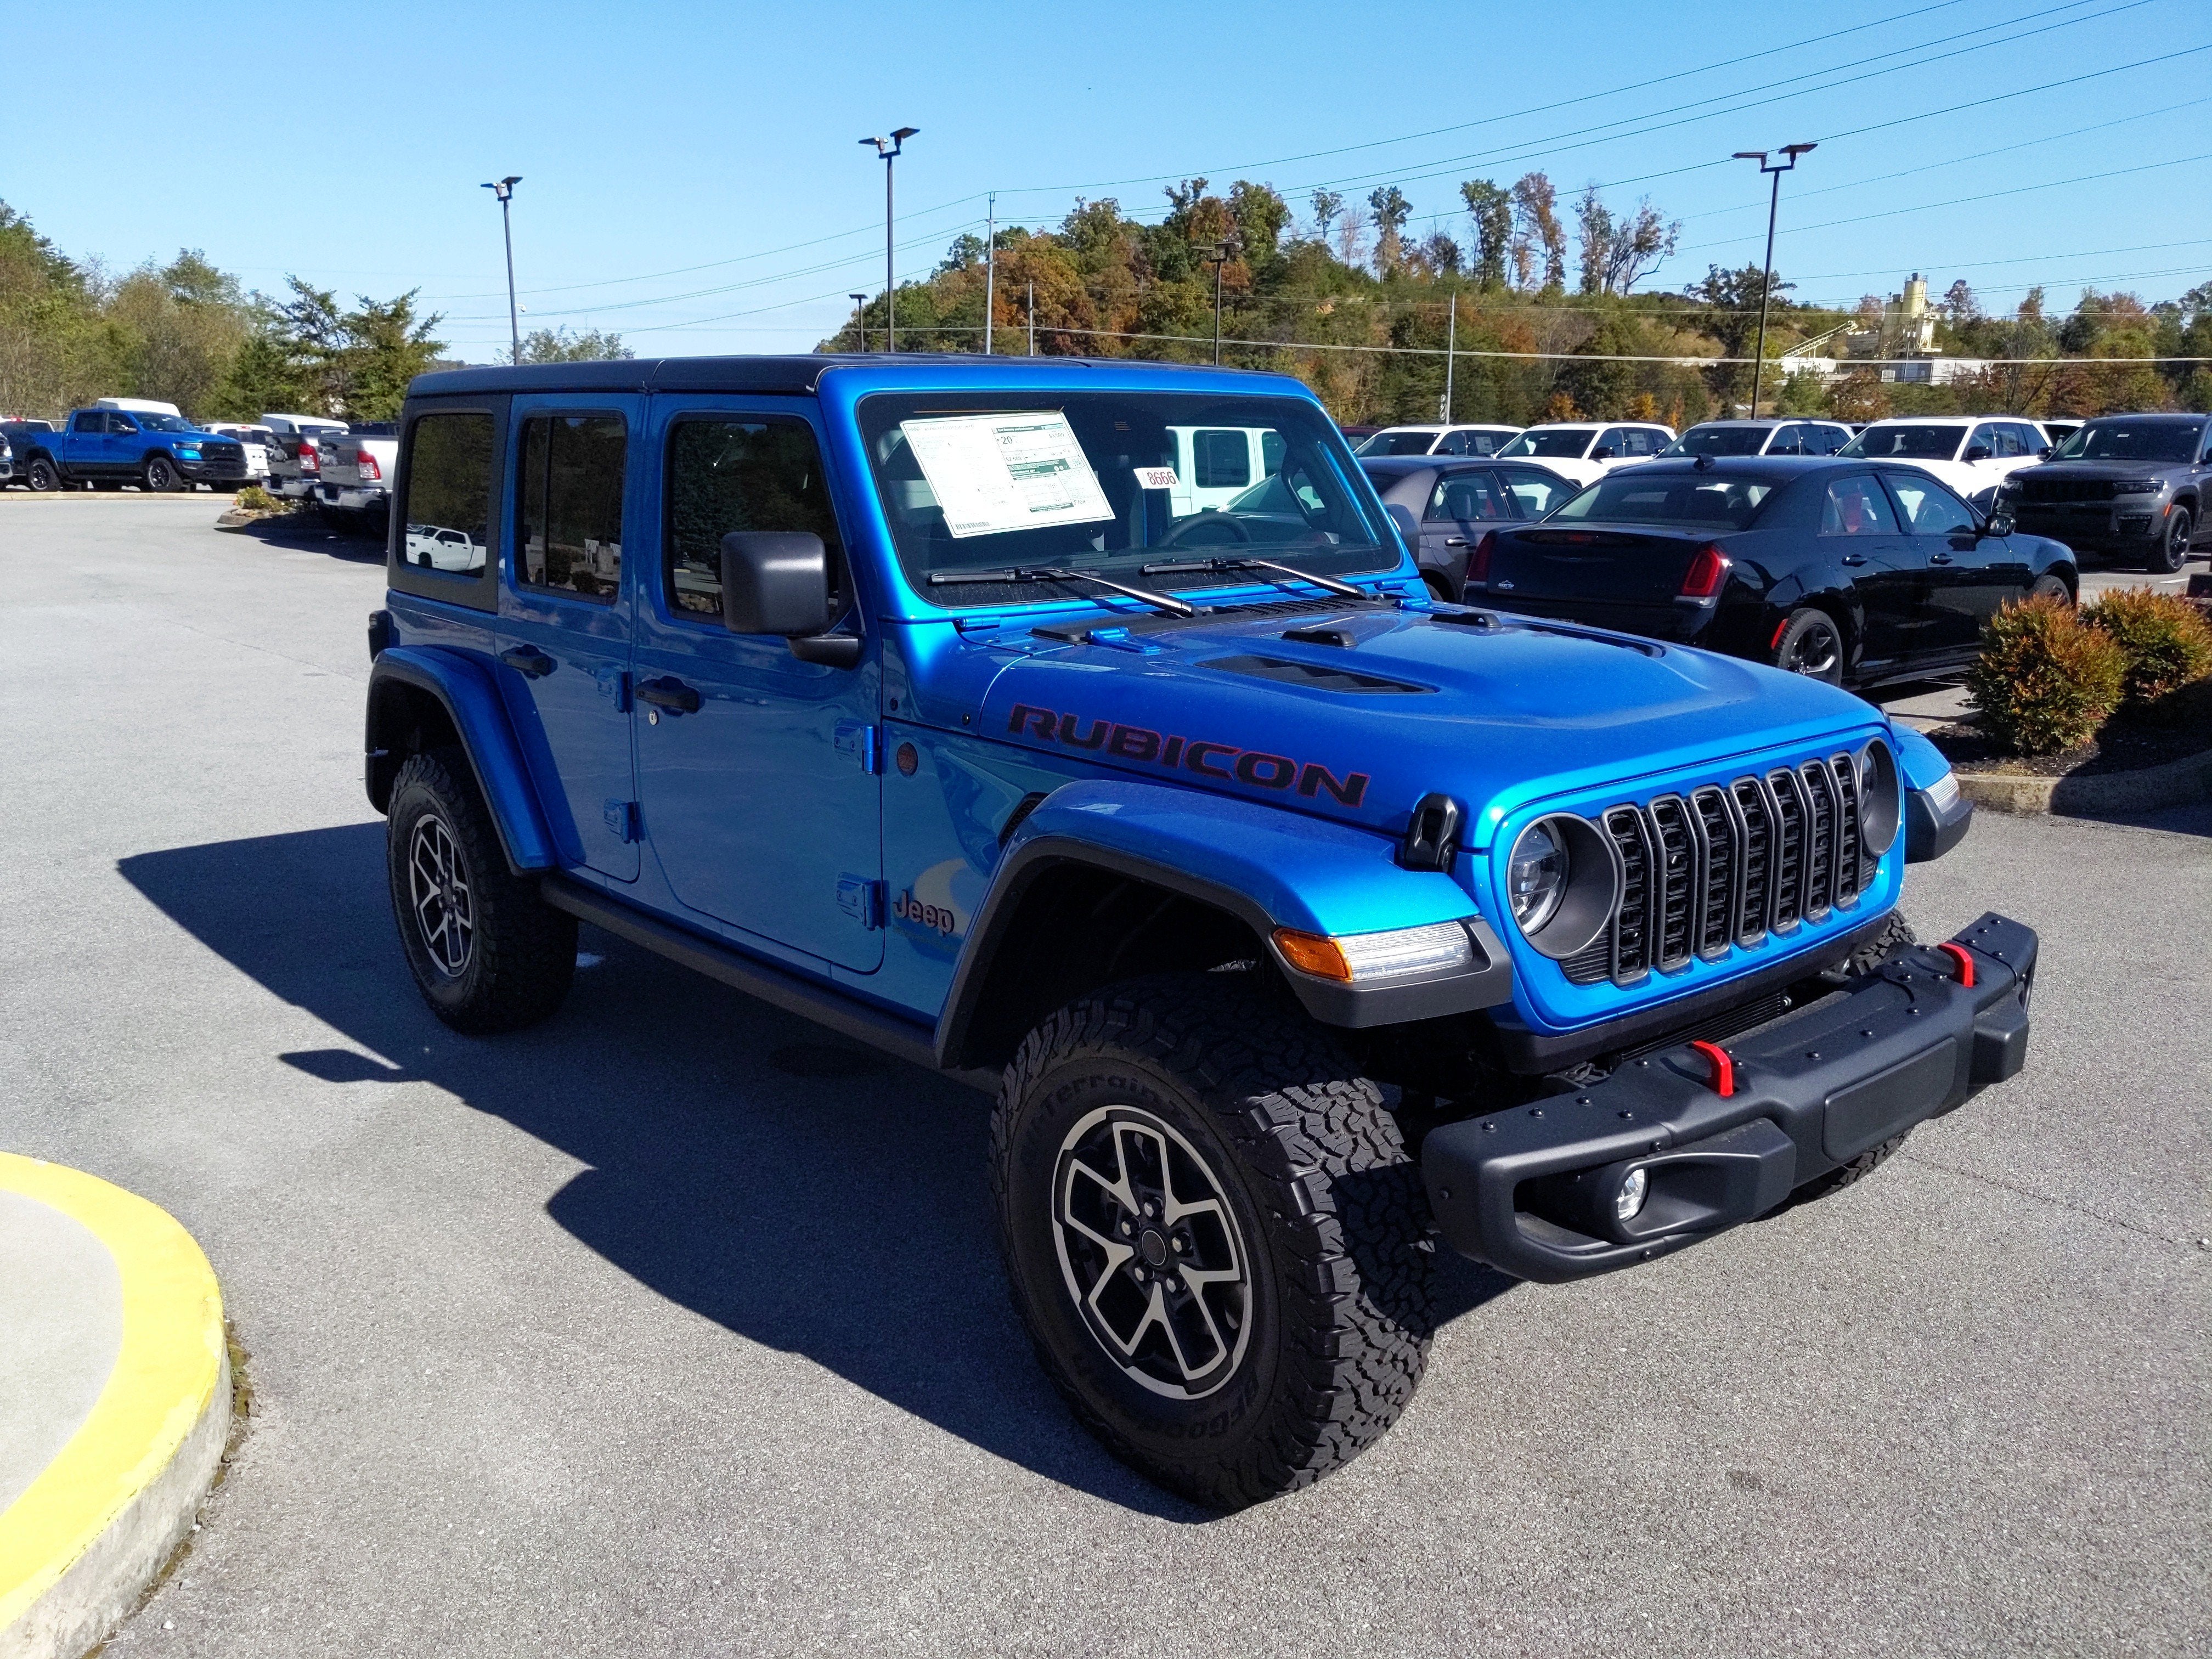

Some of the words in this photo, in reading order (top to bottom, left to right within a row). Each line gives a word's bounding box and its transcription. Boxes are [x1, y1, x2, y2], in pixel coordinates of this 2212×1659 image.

[1001, 436, 1013, 444] 20
[1147, 471, 1176, 485] 8666
[1007, 703, 1371, 808] RUBICON
[893, 889, 955, 936] Jeep
